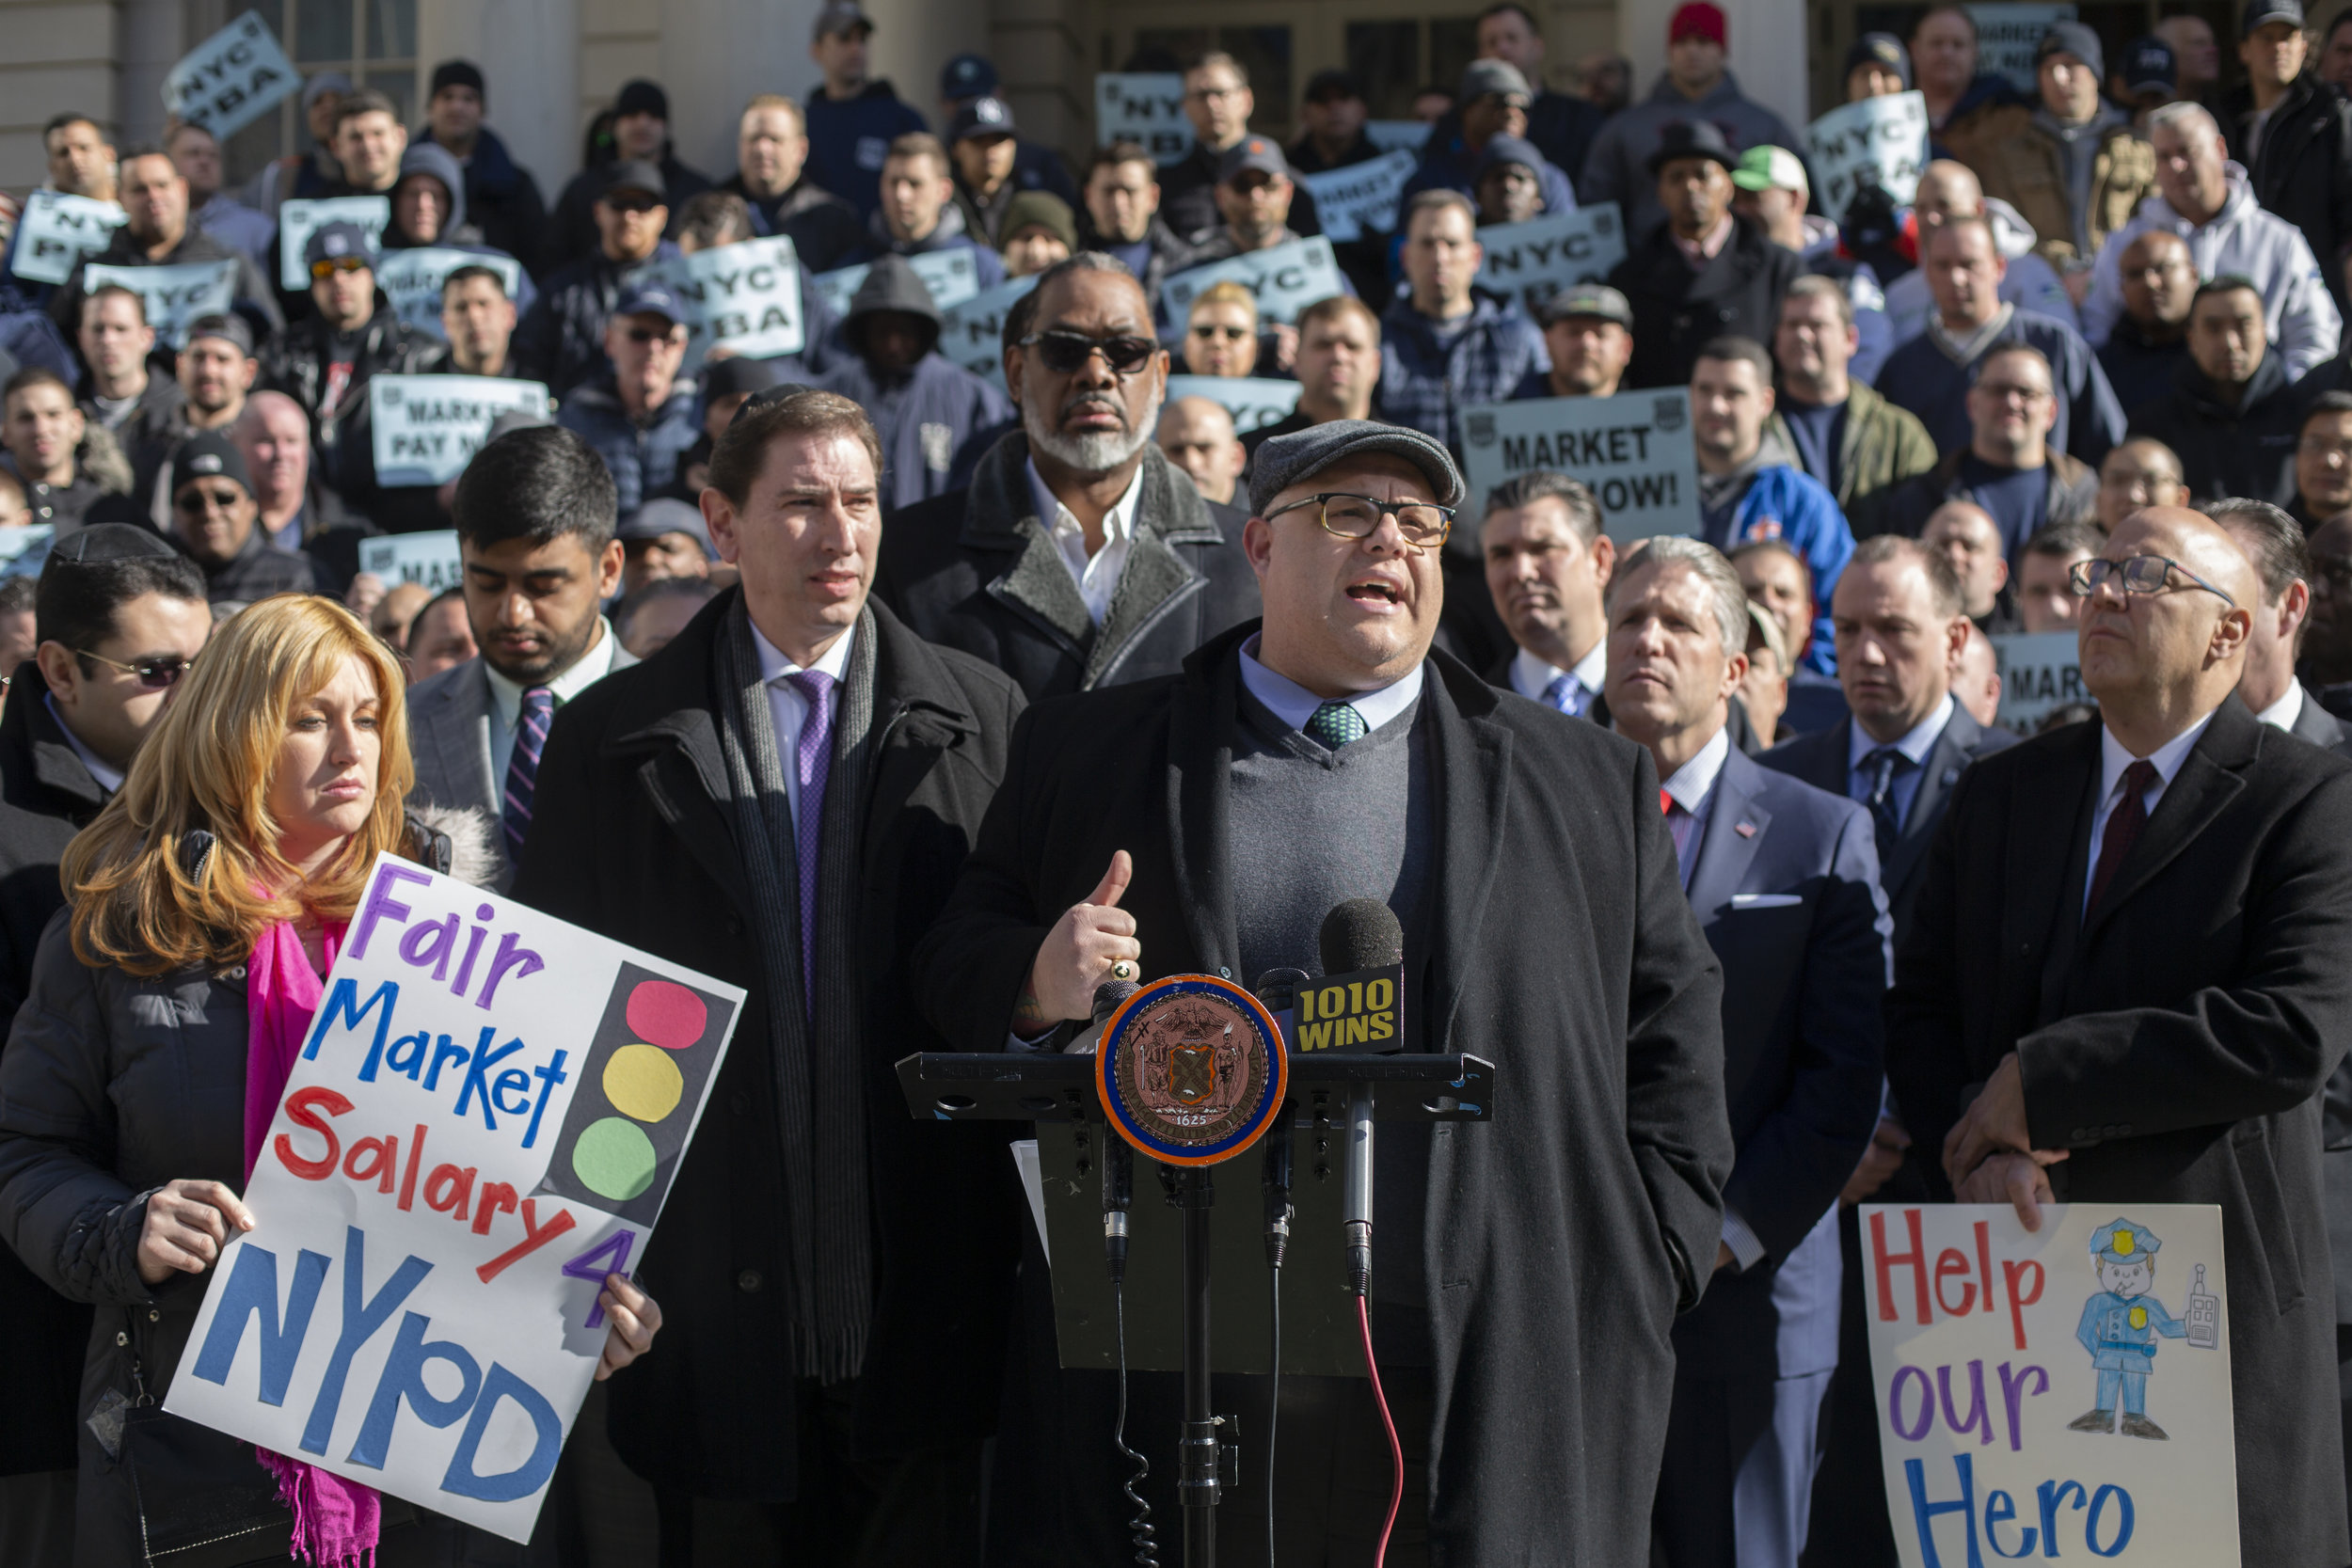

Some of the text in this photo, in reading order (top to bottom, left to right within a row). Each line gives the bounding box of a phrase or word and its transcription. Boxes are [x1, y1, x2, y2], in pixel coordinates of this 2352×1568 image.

[176, 40, 255, 103] NYC
[1124, 96, 1182, 119] NY
[1488, 232, 1593, 276] NYC
[675, 264, 775, 302] NYC
[1242, 266, 1306, 298] YC
[390, 429, 447, 458] PAY
[1501, 425, 1651, 470] MARKET
[1592, 473, 1679, 513] OW!
[347, 862, 545, 1010] Fair
[1299, 978, 1393, 1022] 1010
[1298, 1010, 1394, 1052] WINS
[1176, 1115, 1207, 1126] 1625
[274, 1085, 636, 1328] Salary 4
[1868, 1209, 2045, 1350] Help
[1889, 1359, 2050, 1451] our
[1904, 1453, 2136, 1568] Hero
